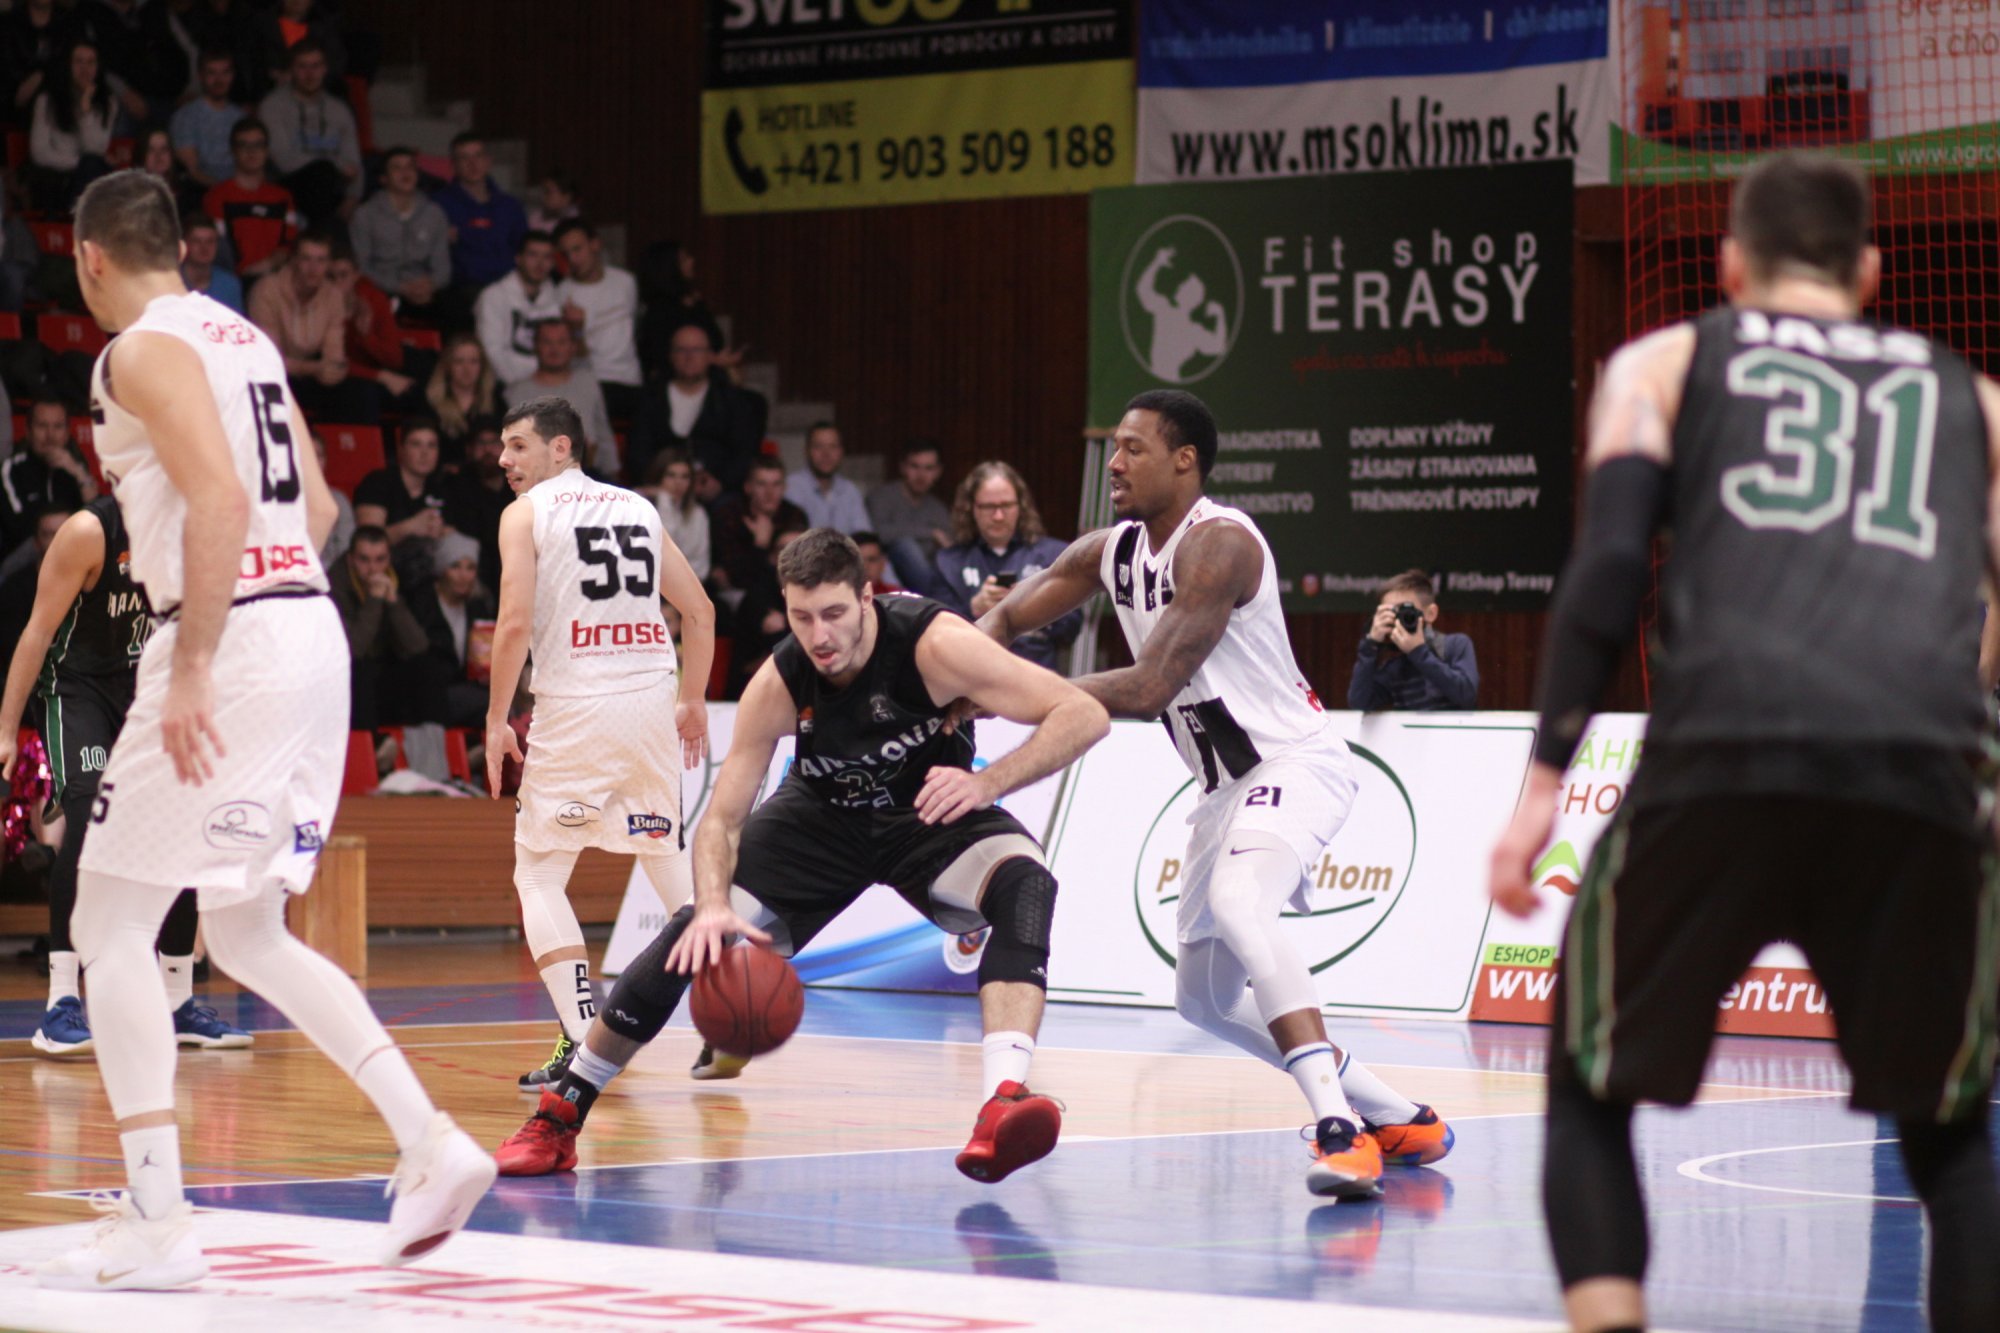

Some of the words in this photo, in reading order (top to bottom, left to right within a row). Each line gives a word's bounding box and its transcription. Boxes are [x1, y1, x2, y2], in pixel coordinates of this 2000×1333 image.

[757, 101, 857, 132] HOTLINE
[1171, 84, 1580, 177] www.msoklima.sk
[774, 142, 862, 186] +421
[878, 136, 947, 180] 903
[960, 129, 1031, 176] 509
[1044, 123, 1116, 170] 188
[1263, 236, 1346, 273] Fit
[1393, 229, 1538, 269] shop
[1261, 262, 1540, 334] TERASY
[1216, 429, 1322, 452] IAGNOSTIKA
[1350, 425, 1428, 449] DOPLNKY
[1431, 420, 1494, 446] VÝŽIVY
[1350, 455, 1416, 480] ZÁSADY
[1419, 454, 1538, 478] STRAVOVANIA
[1720, 346, 1939, 560] 31
[1208, 462, 1276, 483] OTREBY
[1350, 485, 1456, 512] TRÉNINGOVÉ
[1459, 487, 1540, 510] POSTUPY
[574, 524, 655, 602] 55
[570, 620, 667, 648] brose
[80, 746, 107, 772] 10
[1245, 785, 1282, 807] 21
[1492, 946, 1551, 964] ESHOP
[1718, 972, 1830, 1015] entru
